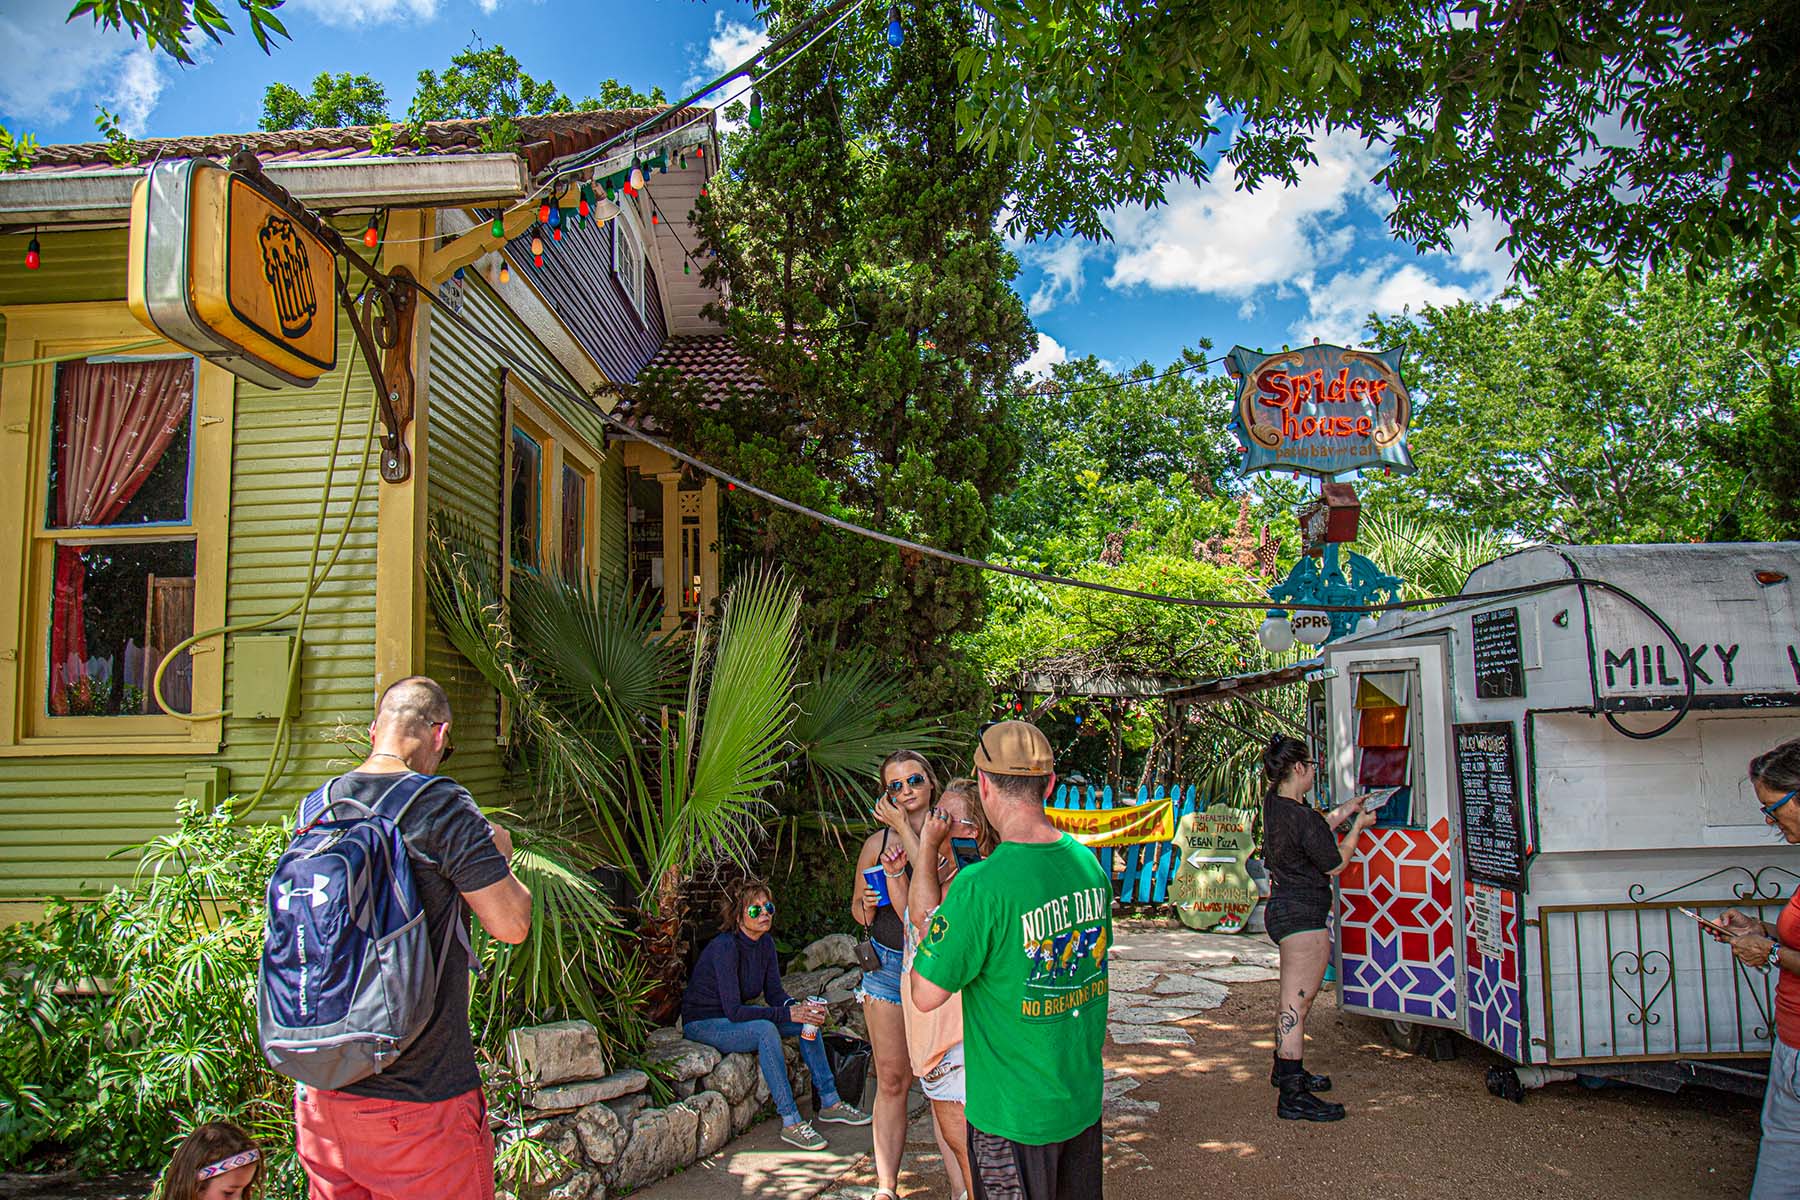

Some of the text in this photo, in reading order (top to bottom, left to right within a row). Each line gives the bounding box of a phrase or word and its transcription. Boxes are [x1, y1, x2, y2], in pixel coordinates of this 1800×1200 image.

[1257, 368, 1388, 414] Spider
[1281, 407, 1372, 441] house
[1604, 642, 1740, 689] MILKY
[1046, 809, 1166, 839] ONY'S PIZZA
[1186, 836, 1213, 848] VEGAN
[1021, 895, 1072, 946] NOTRE
[296, 924, 308, 1016] UNDER ARMOUR
[1022, 1000, 1041, 1017] NO
[1044, 988, 1090, 1015] BREAKING
